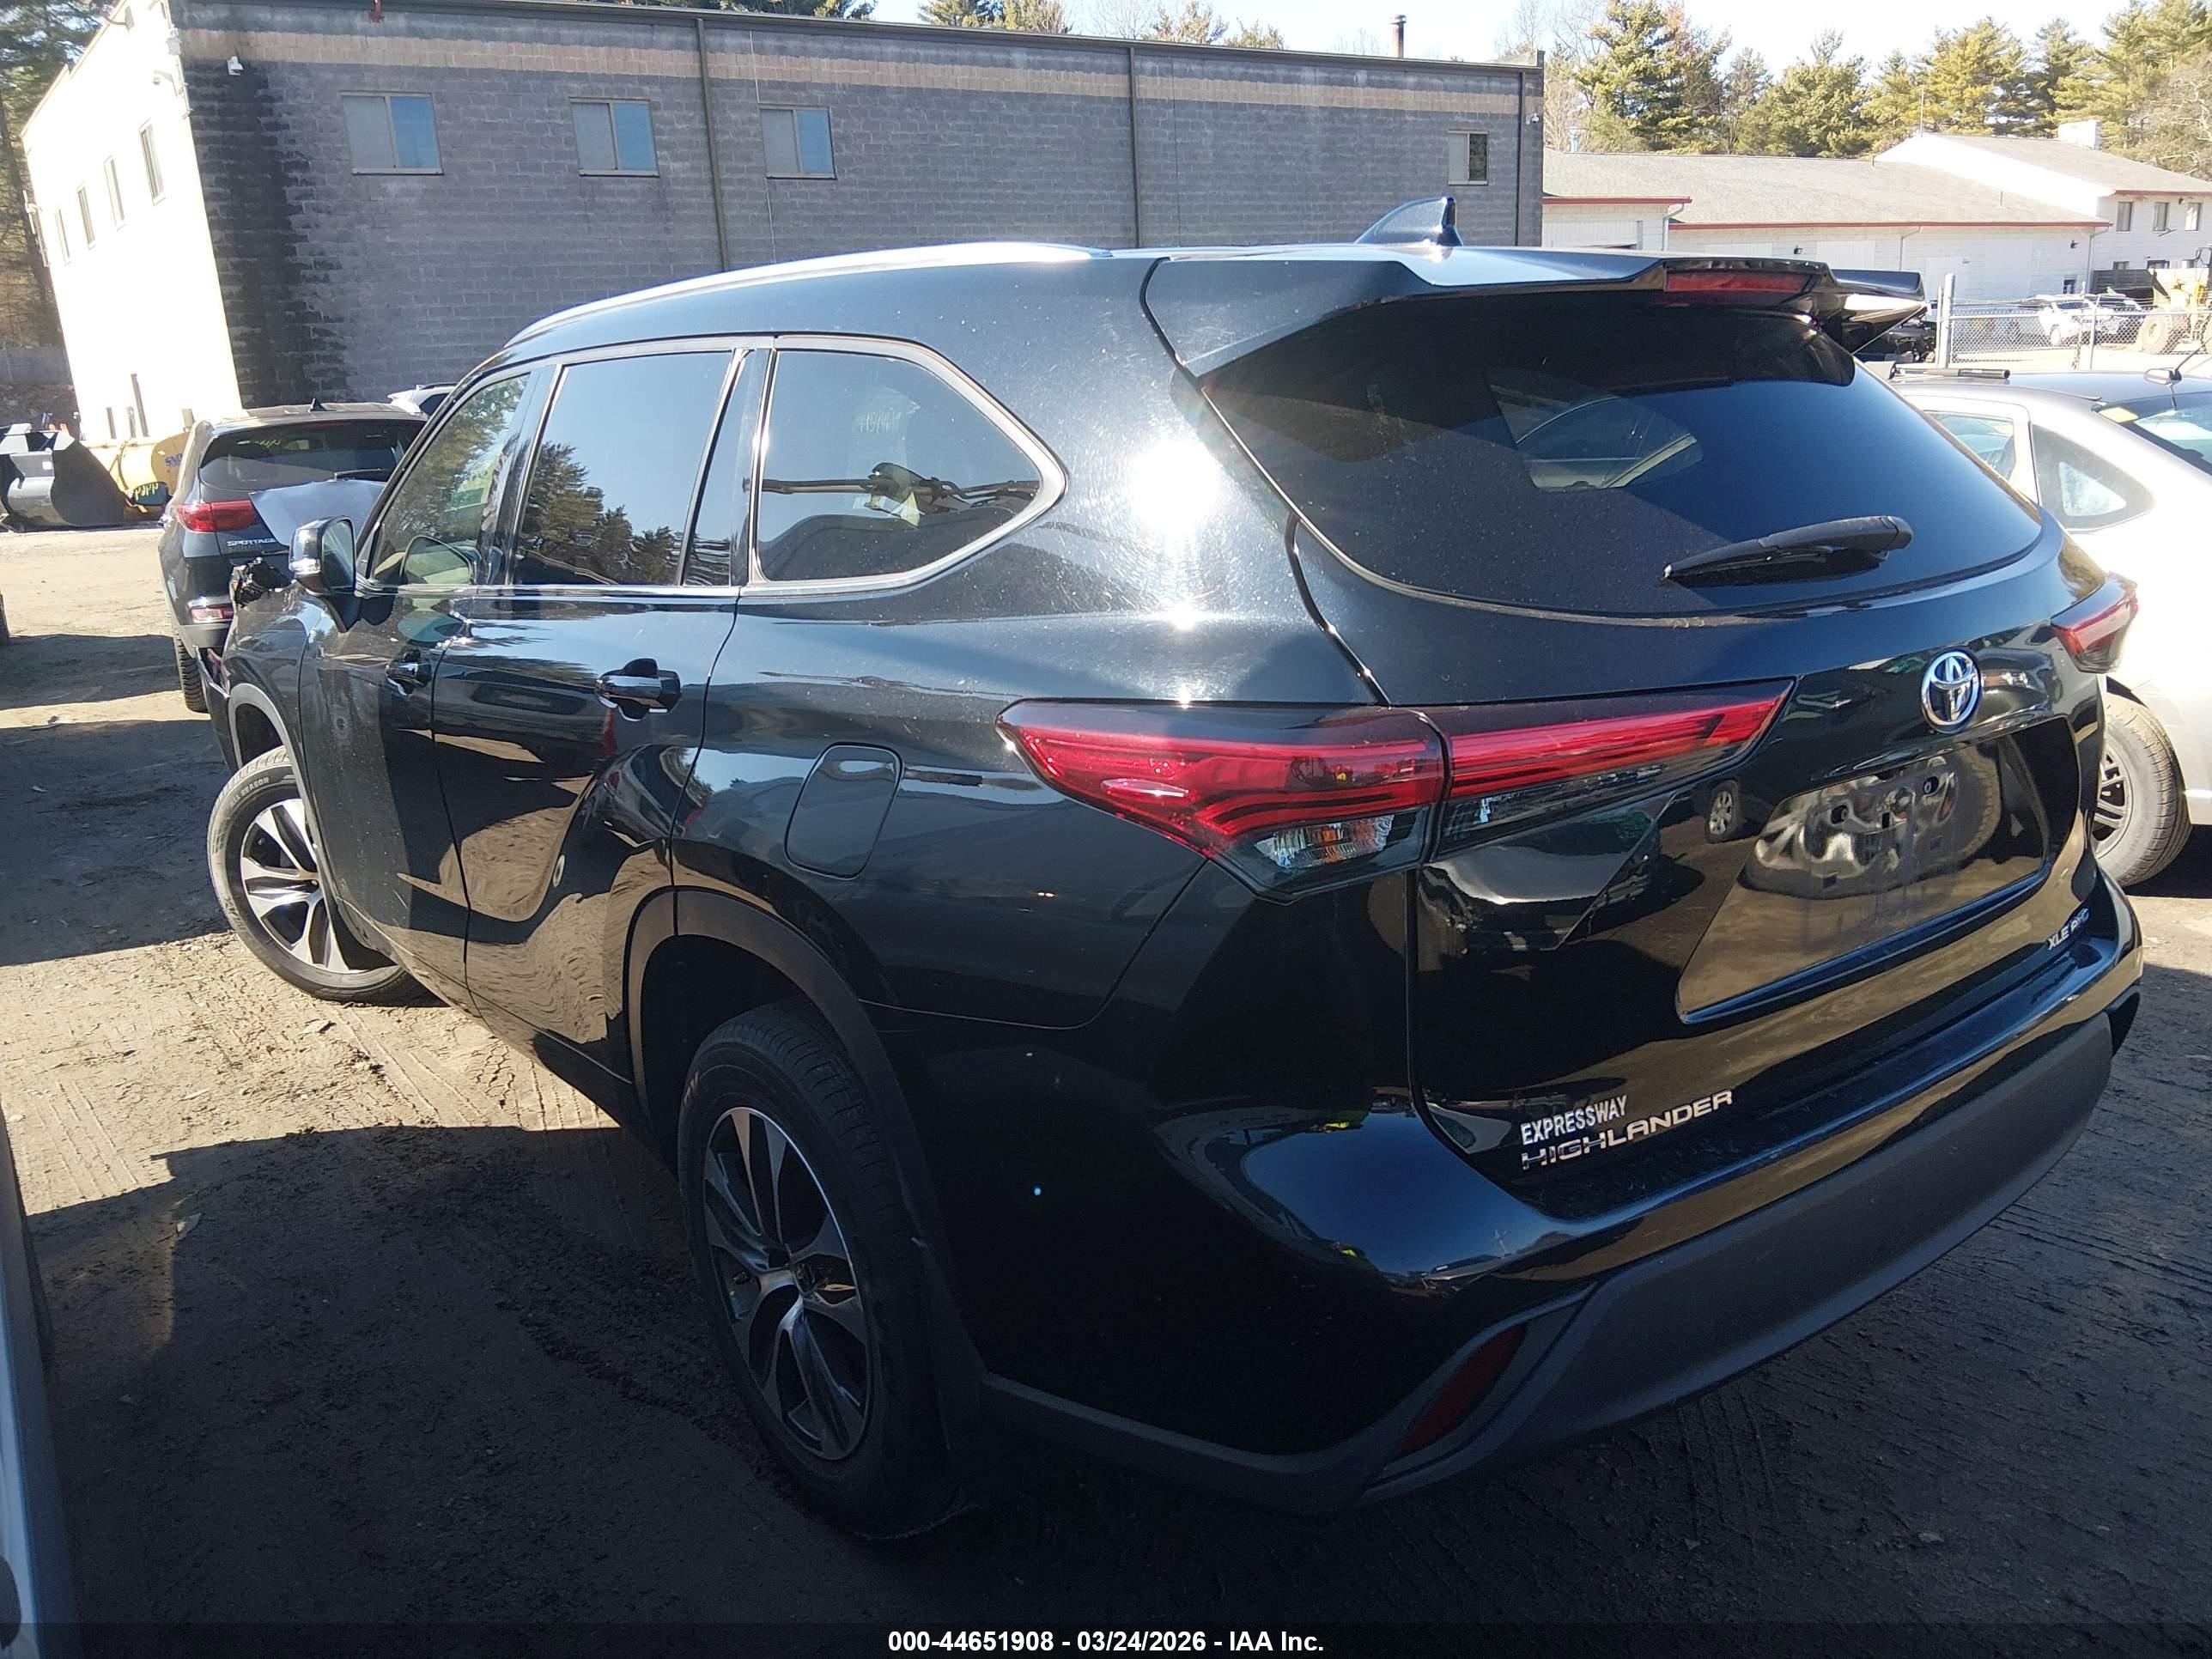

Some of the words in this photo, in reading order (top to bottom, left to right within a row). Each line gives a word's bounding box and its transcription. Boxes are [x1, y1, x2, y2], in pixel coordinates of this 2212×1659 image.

[2047, 924, 2070, 951] XLE
[1521, 1095, 1627, 1146] EXPRESSWAY
[1522, 1089, 1733, 1170] HIGHLANDER
